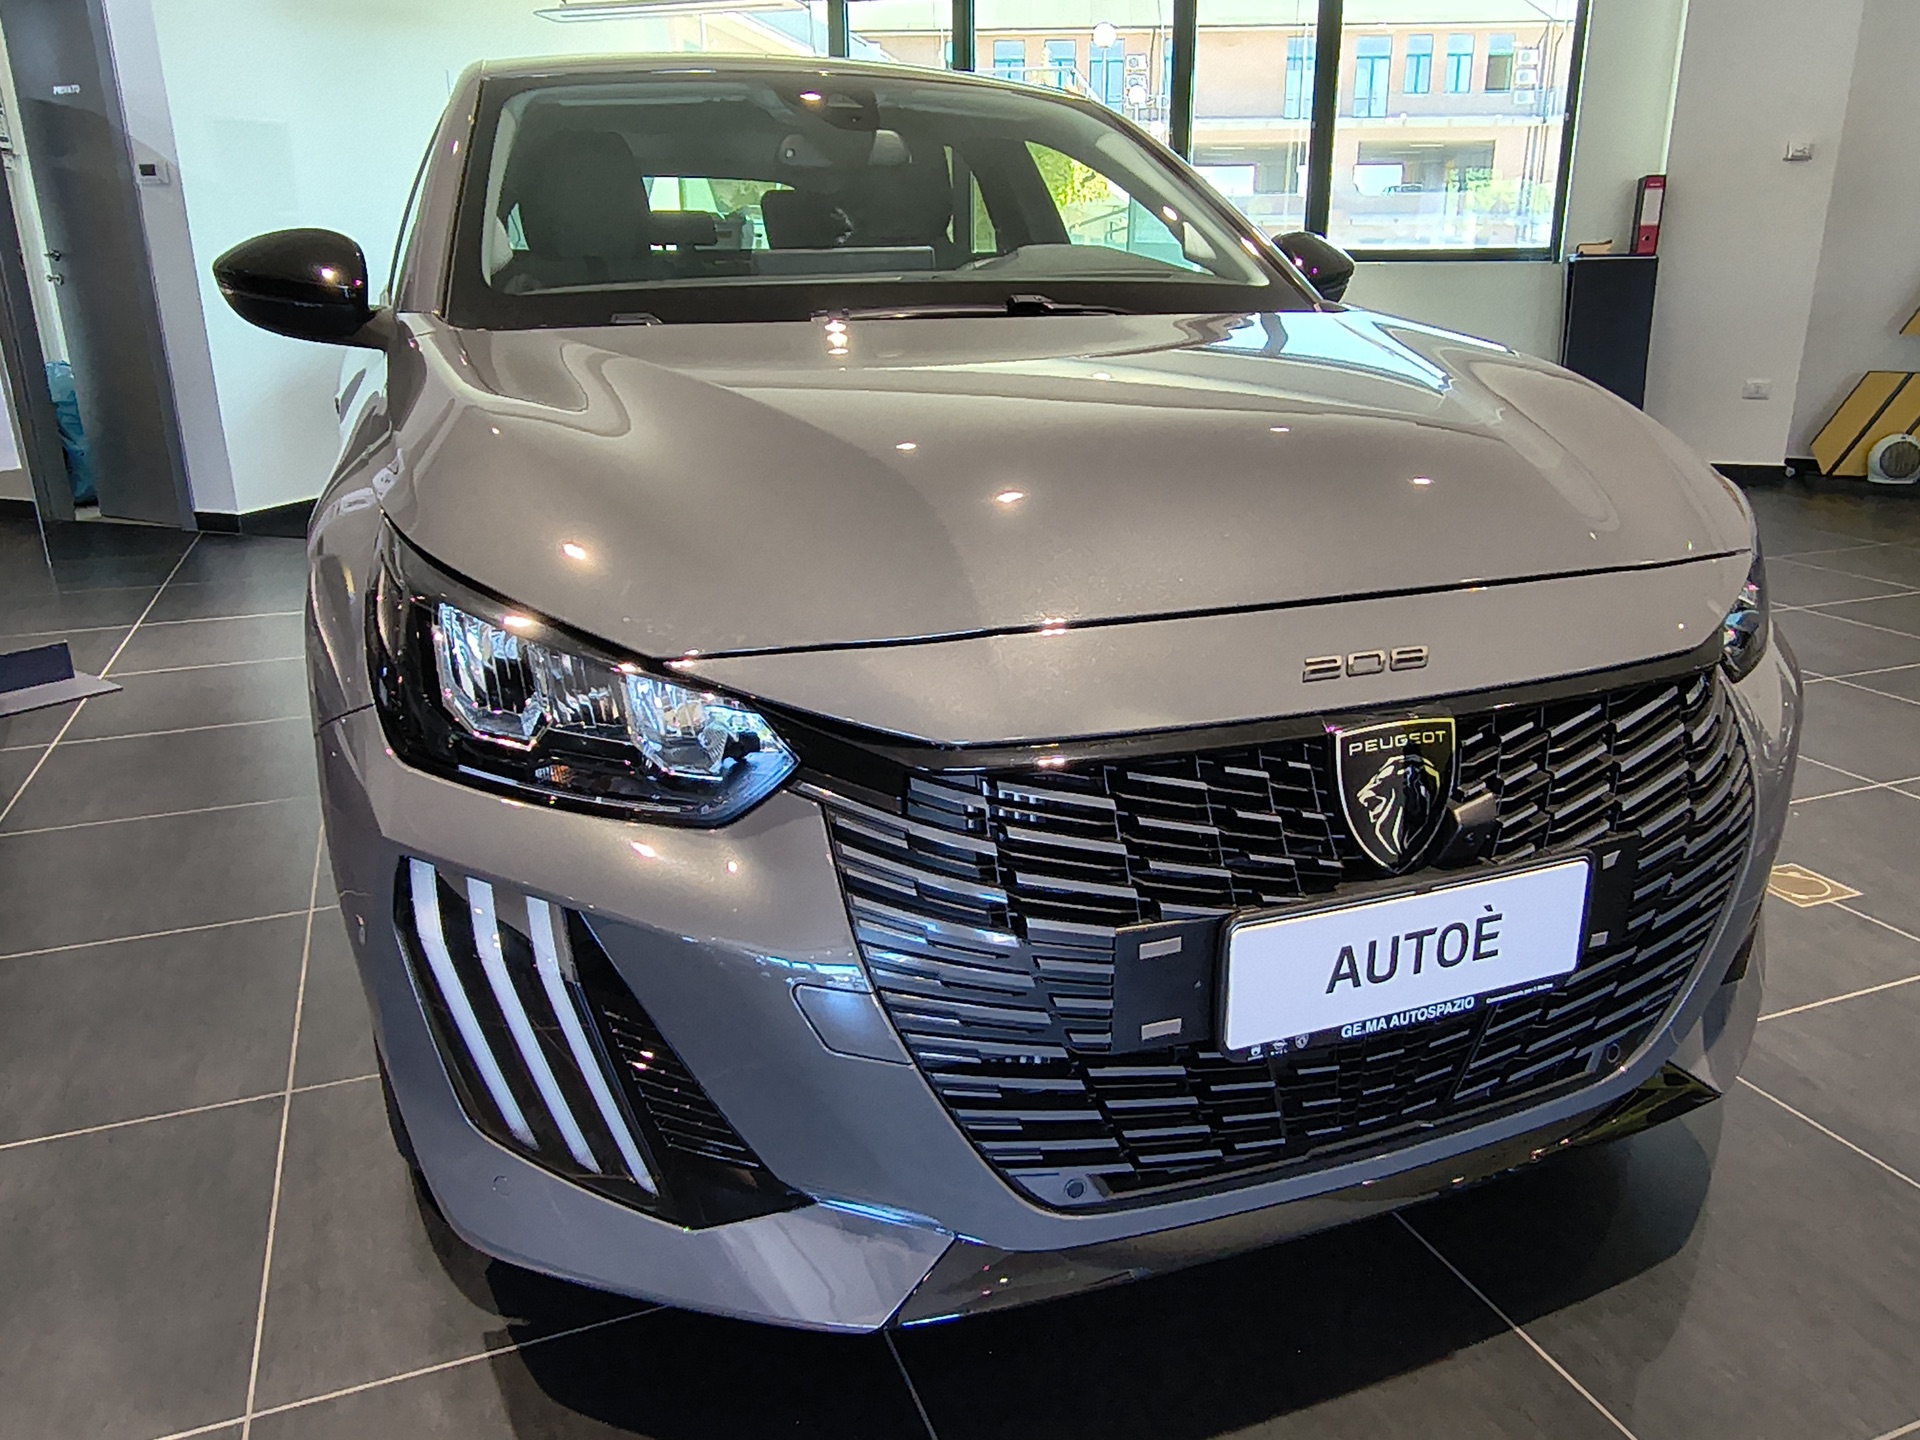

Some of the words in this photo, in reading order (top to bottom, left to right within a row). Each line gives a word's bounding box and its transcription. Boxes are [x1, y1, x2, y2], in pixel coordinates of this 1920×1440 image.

[1302, 645, 1429, 683] 208
[1349, 730, 1447, 757] PEUGEOT
[1325, 904, 1503, 994] AUTOÈ
[1340, 1017, 1388, 1039] GE.MA
[1389, 996, 1475, 1028] AUTOSPAZIO
